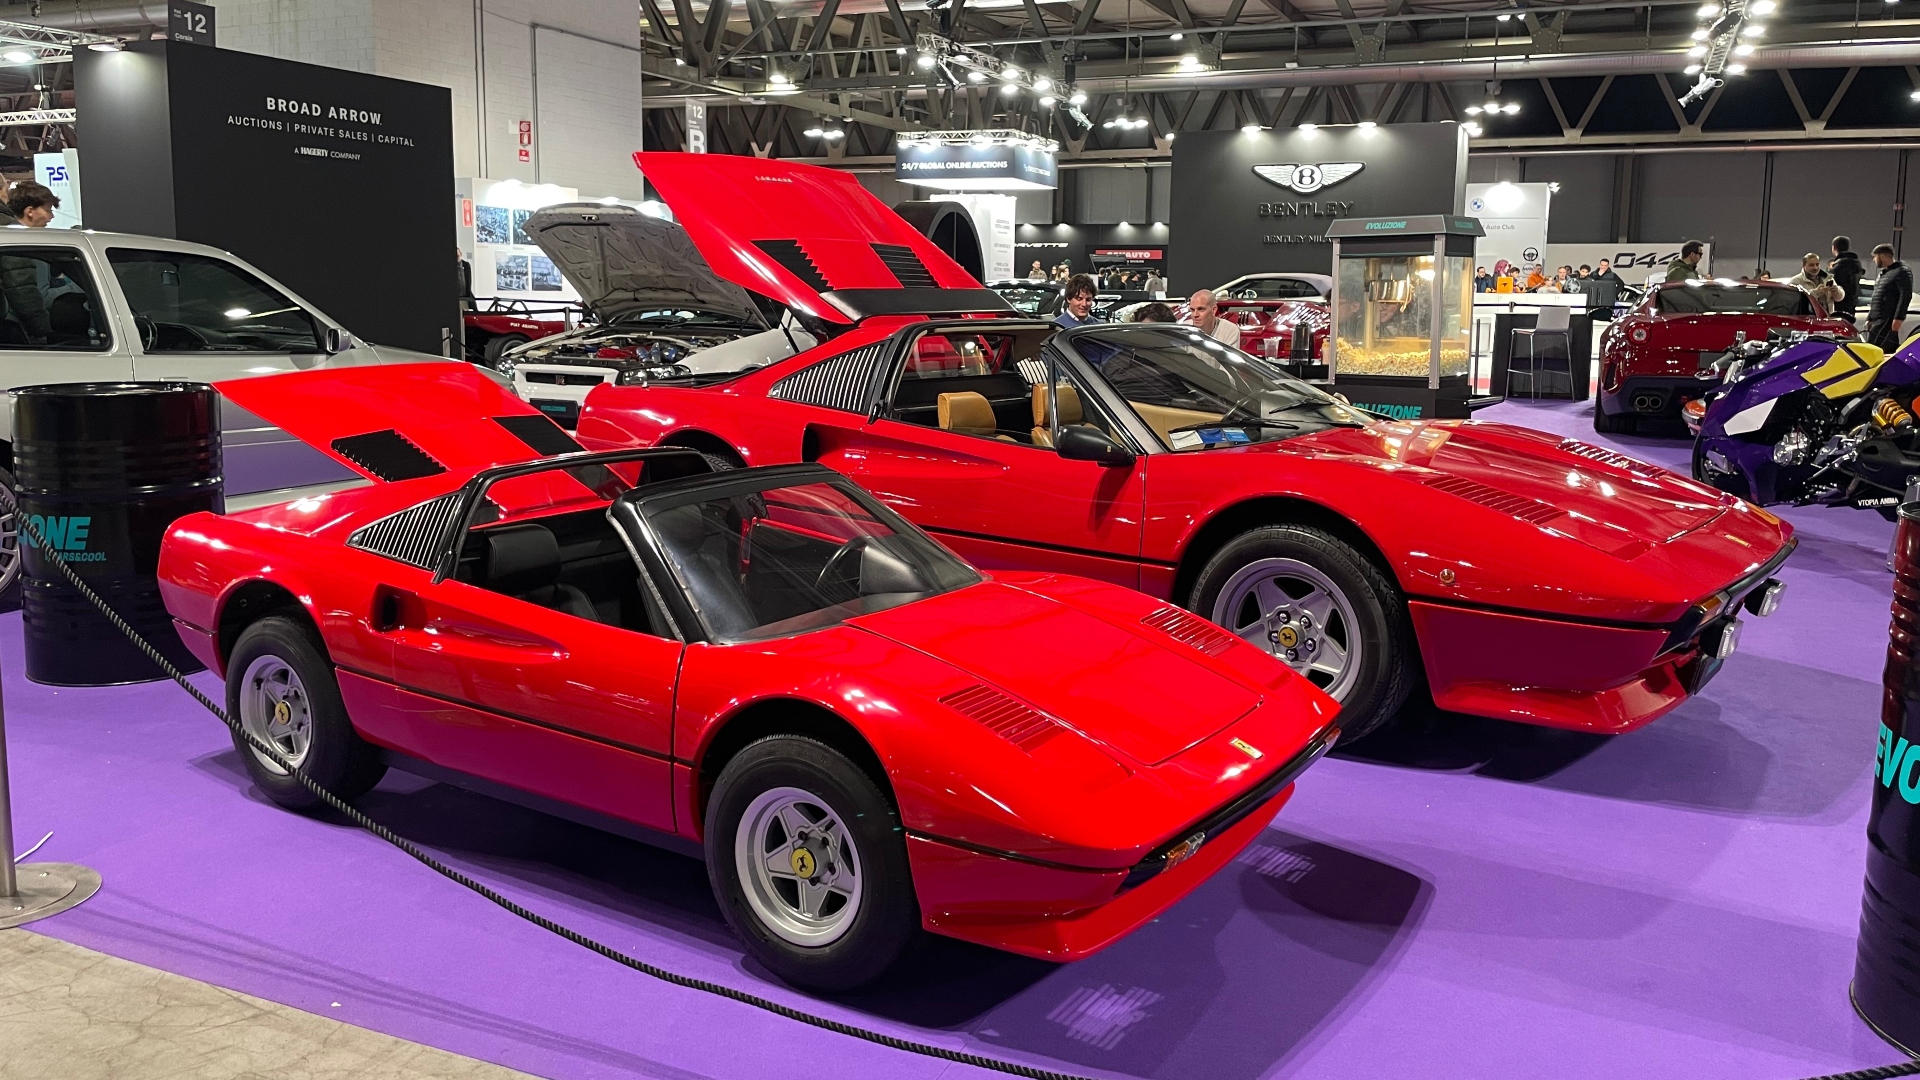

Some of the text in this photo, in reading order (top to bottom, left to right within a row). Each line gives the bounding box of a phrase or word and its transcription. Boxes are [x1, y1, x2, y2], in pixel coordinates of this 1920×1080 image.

[183, 11, 207, 34] 12
[266, 96, 321, 117] BROAD
[692, 105, 703, 119] 12
[227, 115, 283, 131] AUCTIONS
[294, 123, 335, 137] PRIVATE
[338, 129, 368, 141] SALES
[377, 134, 415, 147] CAPITAL
[294, 146, 361, 161] A HAGERTY COMPANY
[901, 161, 1008, 171] 24/7 GLOBAL ONLINE AUCTIONS
[1259, 201, 1353, 217] BENTLEY
[1365, 221, 1407, 230] EVOLUZIONE
[1263, 234, 1306, 244] BENTLEY
[1260, 530, 1302, 543] PIRELLI
